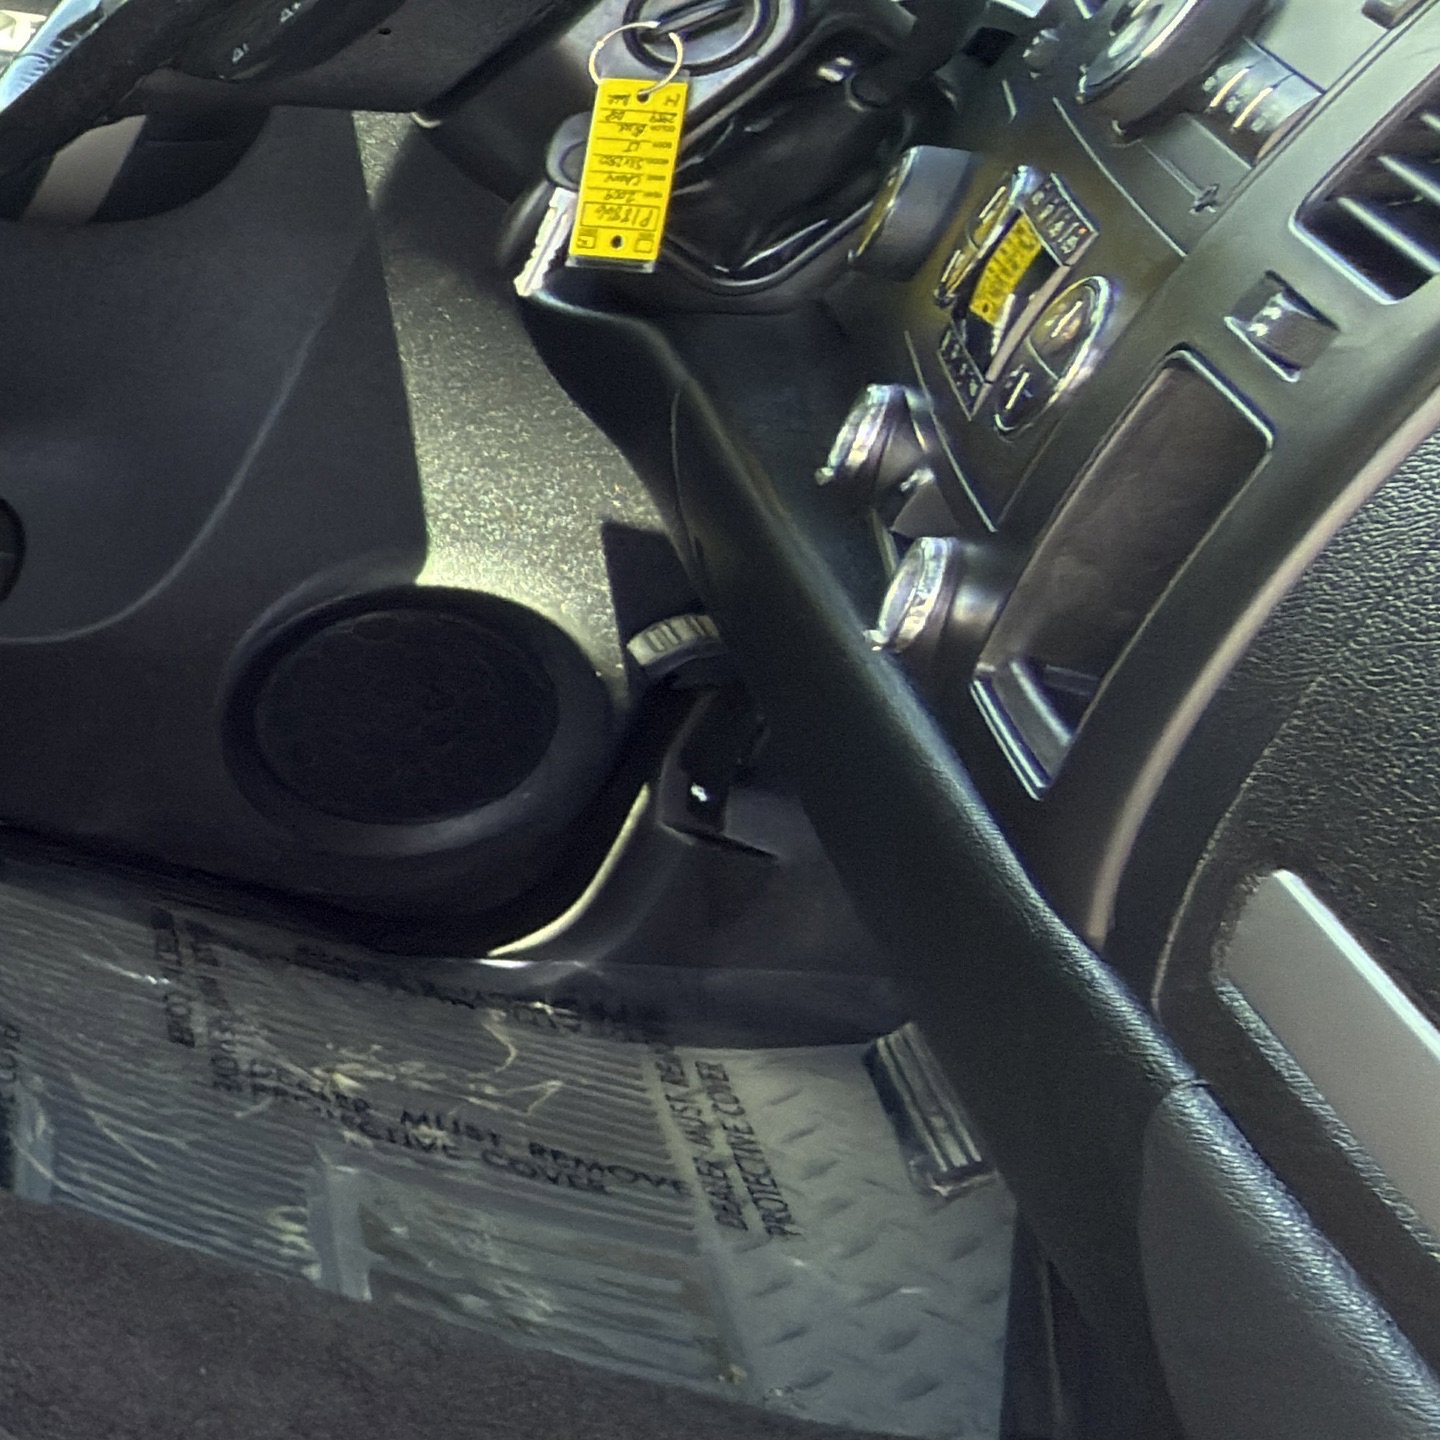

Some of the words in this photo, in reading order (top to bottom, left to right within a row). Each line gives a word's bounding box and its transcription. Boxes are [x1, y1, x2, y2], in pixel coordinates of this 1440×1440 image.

[481, 1147, 609, 1193] COVER
[527, 1139, 687, 1192] REMOVE
[721, 1122, 802, 1236] PROTECTIVE
